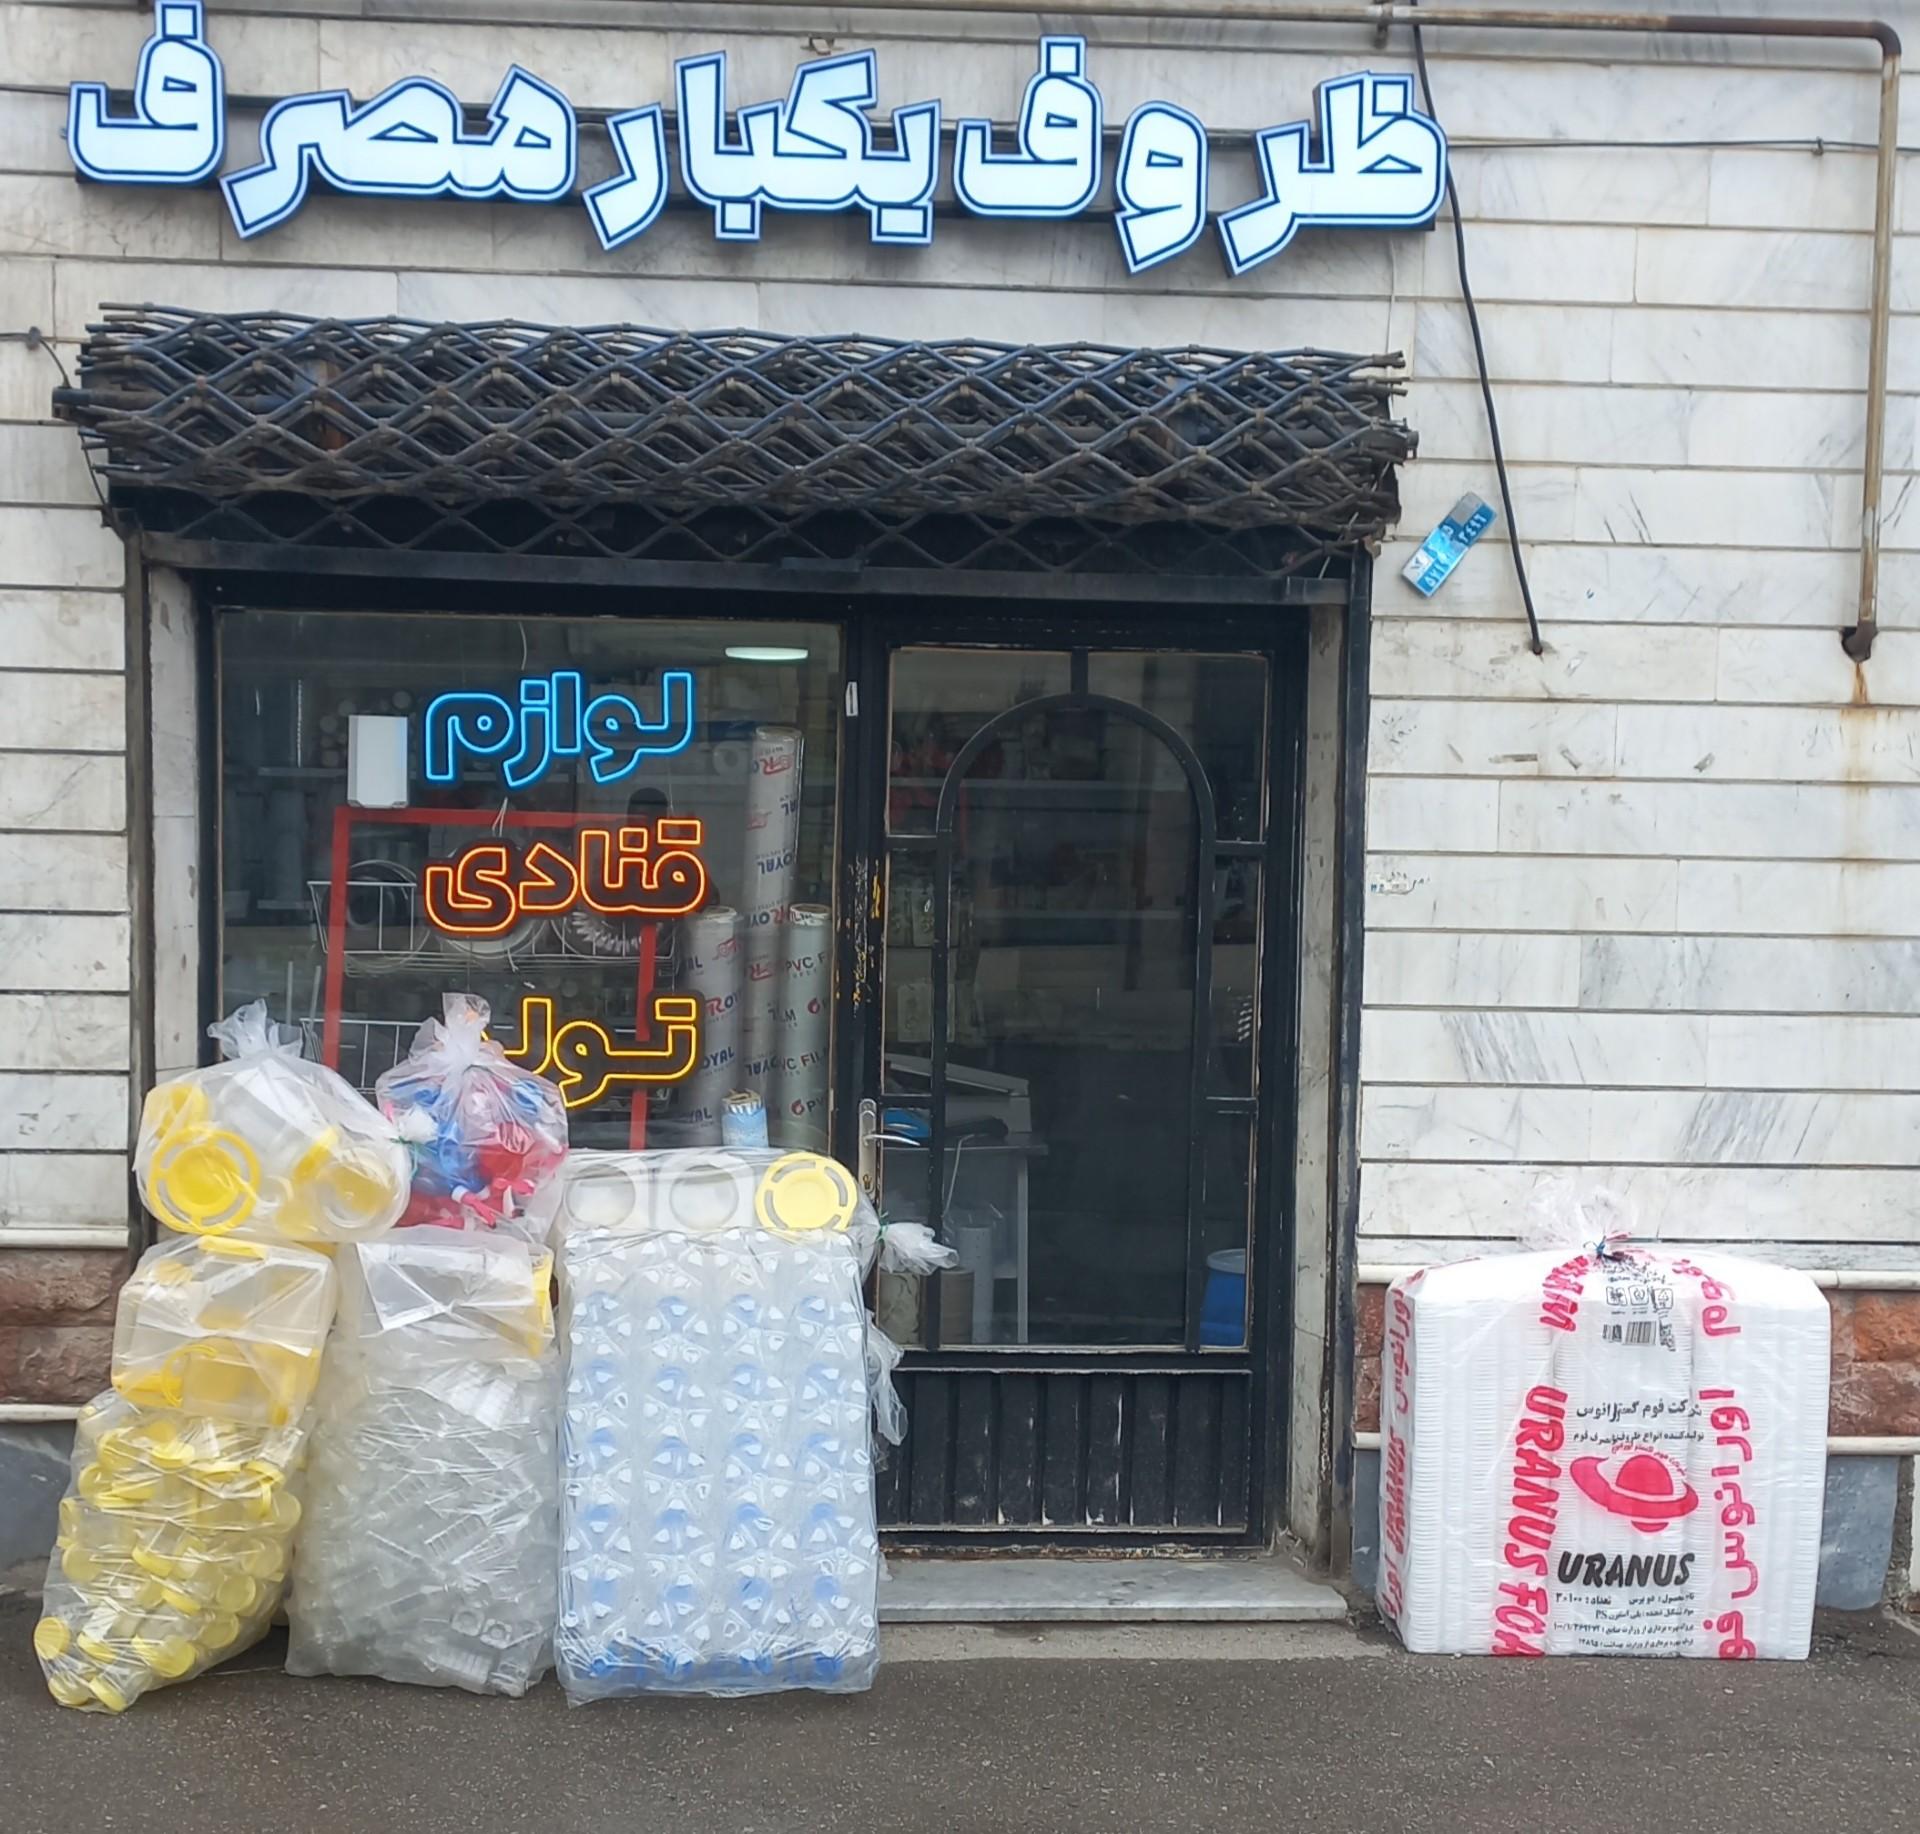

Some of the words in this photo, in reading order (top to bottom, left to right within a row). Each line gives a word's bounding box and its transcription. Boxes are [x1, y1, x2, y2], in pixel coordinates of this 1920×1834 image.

[67, 0, 577, 239] مصرف
[583, 48, 942, 251] یکبار
[953, 34, 1448, 276] ظروف
[426, 671, 693, 787] لوازم
[426, 819, 706, 932] قنادی
[482, 997, 698, 1108] تول
[1503, 1385, 1569, 1577] URANUS
[1699, 1389, 1759, 1600] اورانوس
[1491, 1582, 1549, 1658] FOA
[1558, 1551, 1696, 1588] URANUS
[1703, 1610, 1757, 1660] فو
